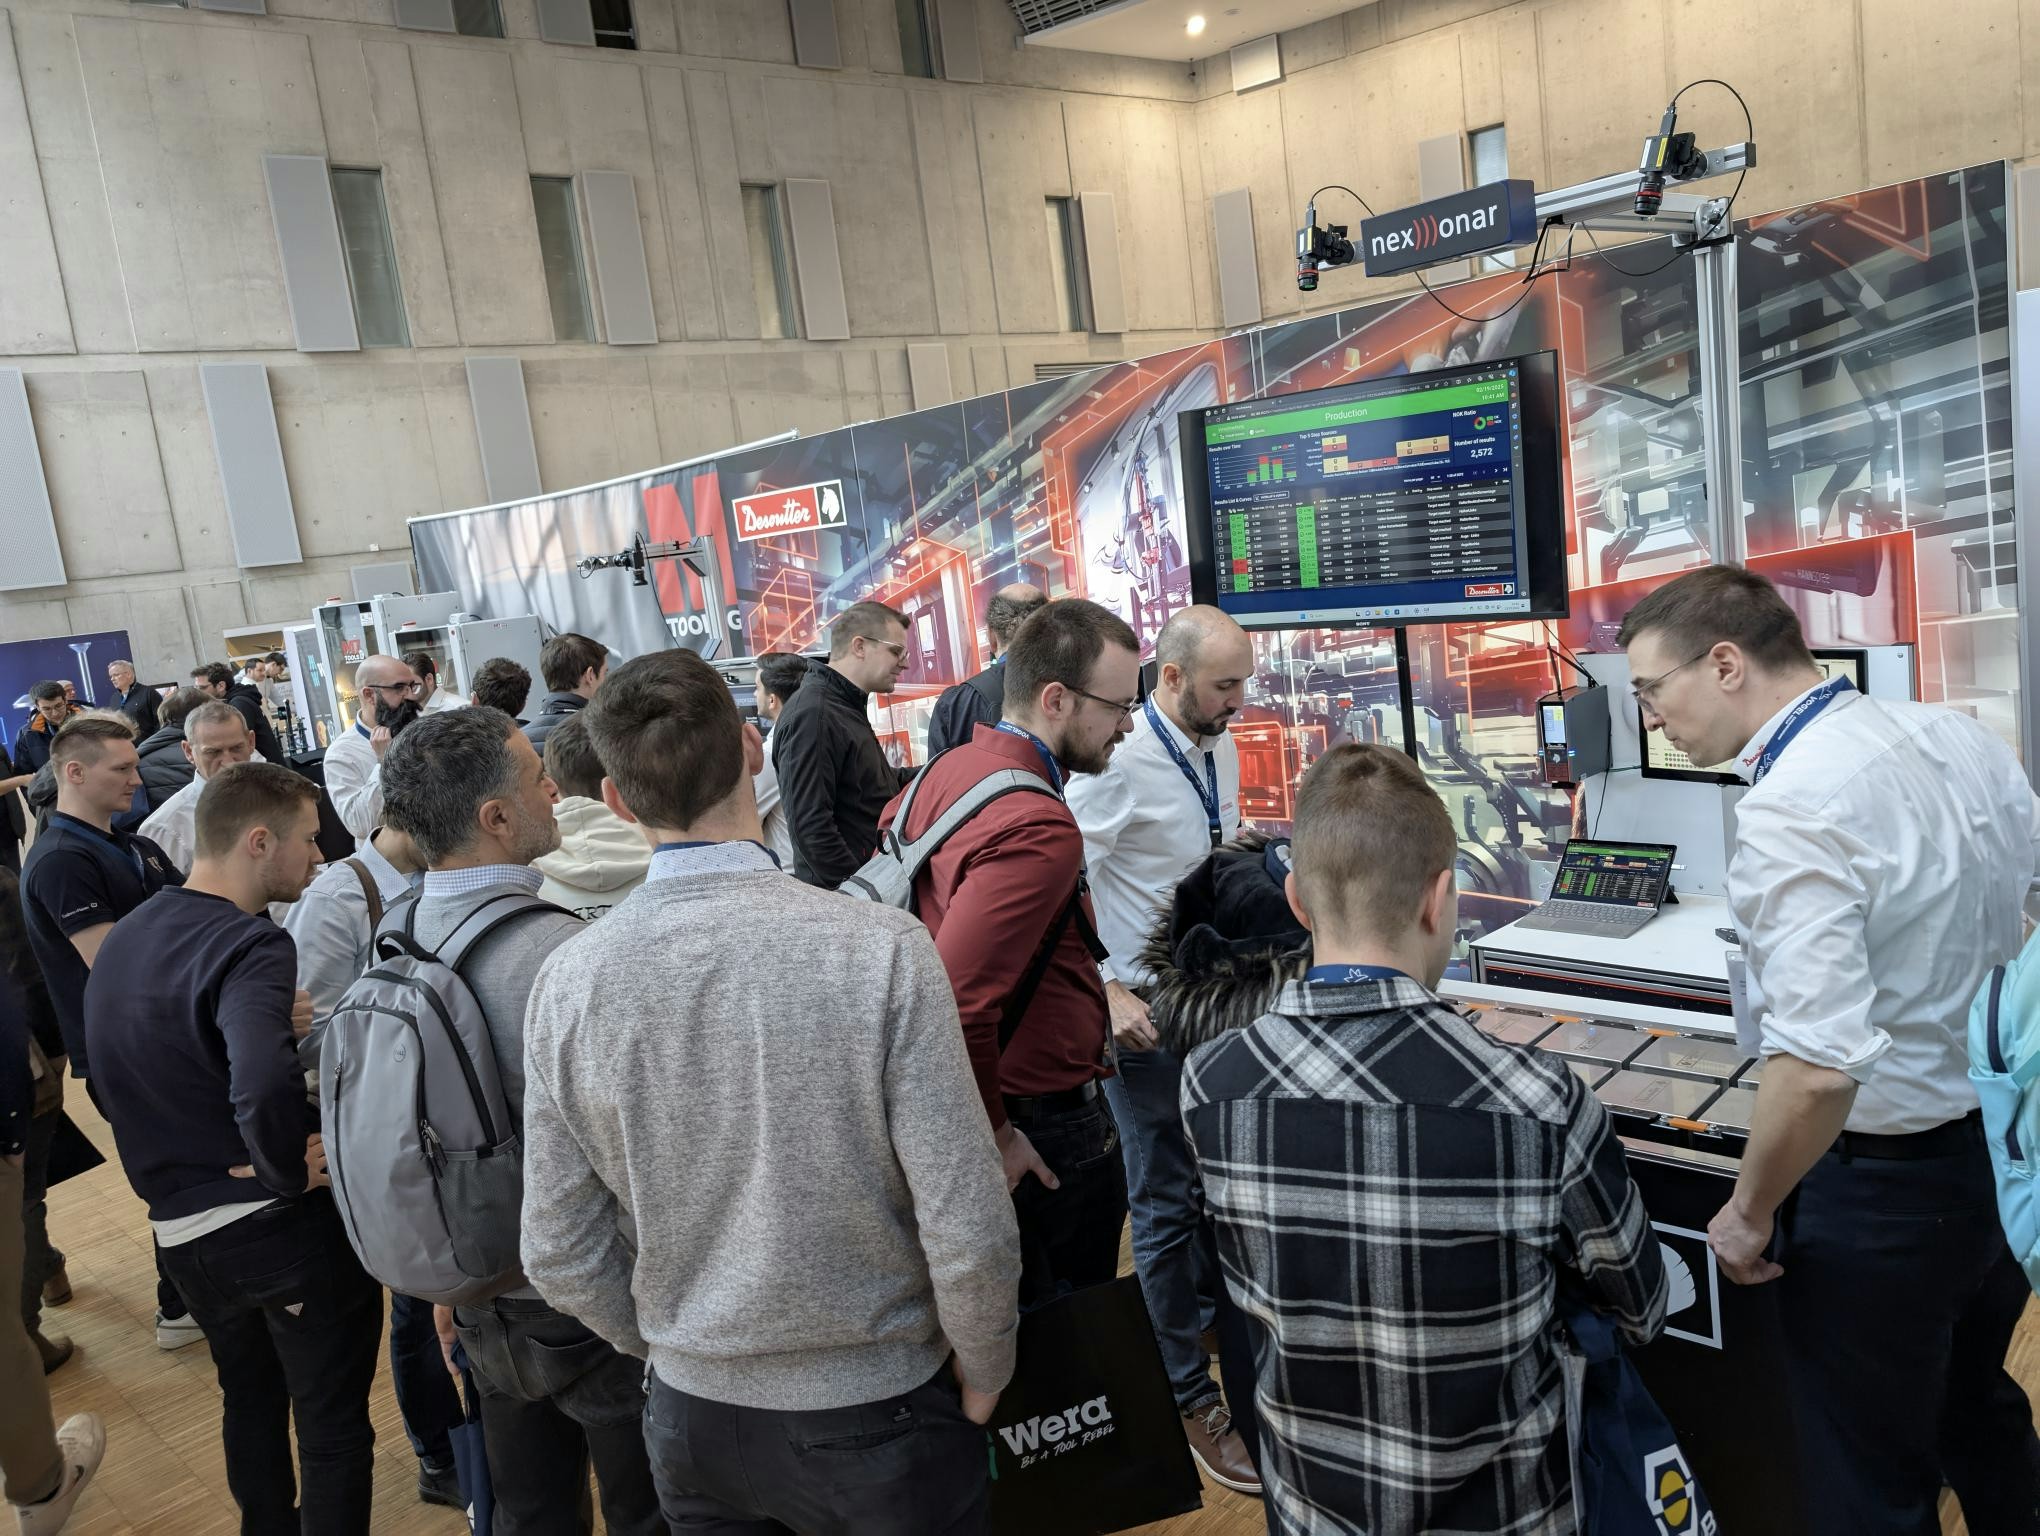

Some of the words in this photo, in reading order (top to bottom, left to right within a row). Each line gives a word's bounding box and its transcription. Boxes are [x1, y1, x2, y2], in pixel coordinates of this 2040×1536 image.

[1325, 408, 1368, 422] Production
[1454, 438, 1473, 447] Number
[1479, 436, 1495, 444] results
[1470, 447, 1493, 458] 2,572
[741, 498, 812, 533] Desoutter
[1792, 696, 1818, 716] VOGEL
[998, 1394, 1113, 1456] Wera
[1053, 1438, 1078, 1457] TOOL
[1081, 1423, 1116, 1447] REBEL
